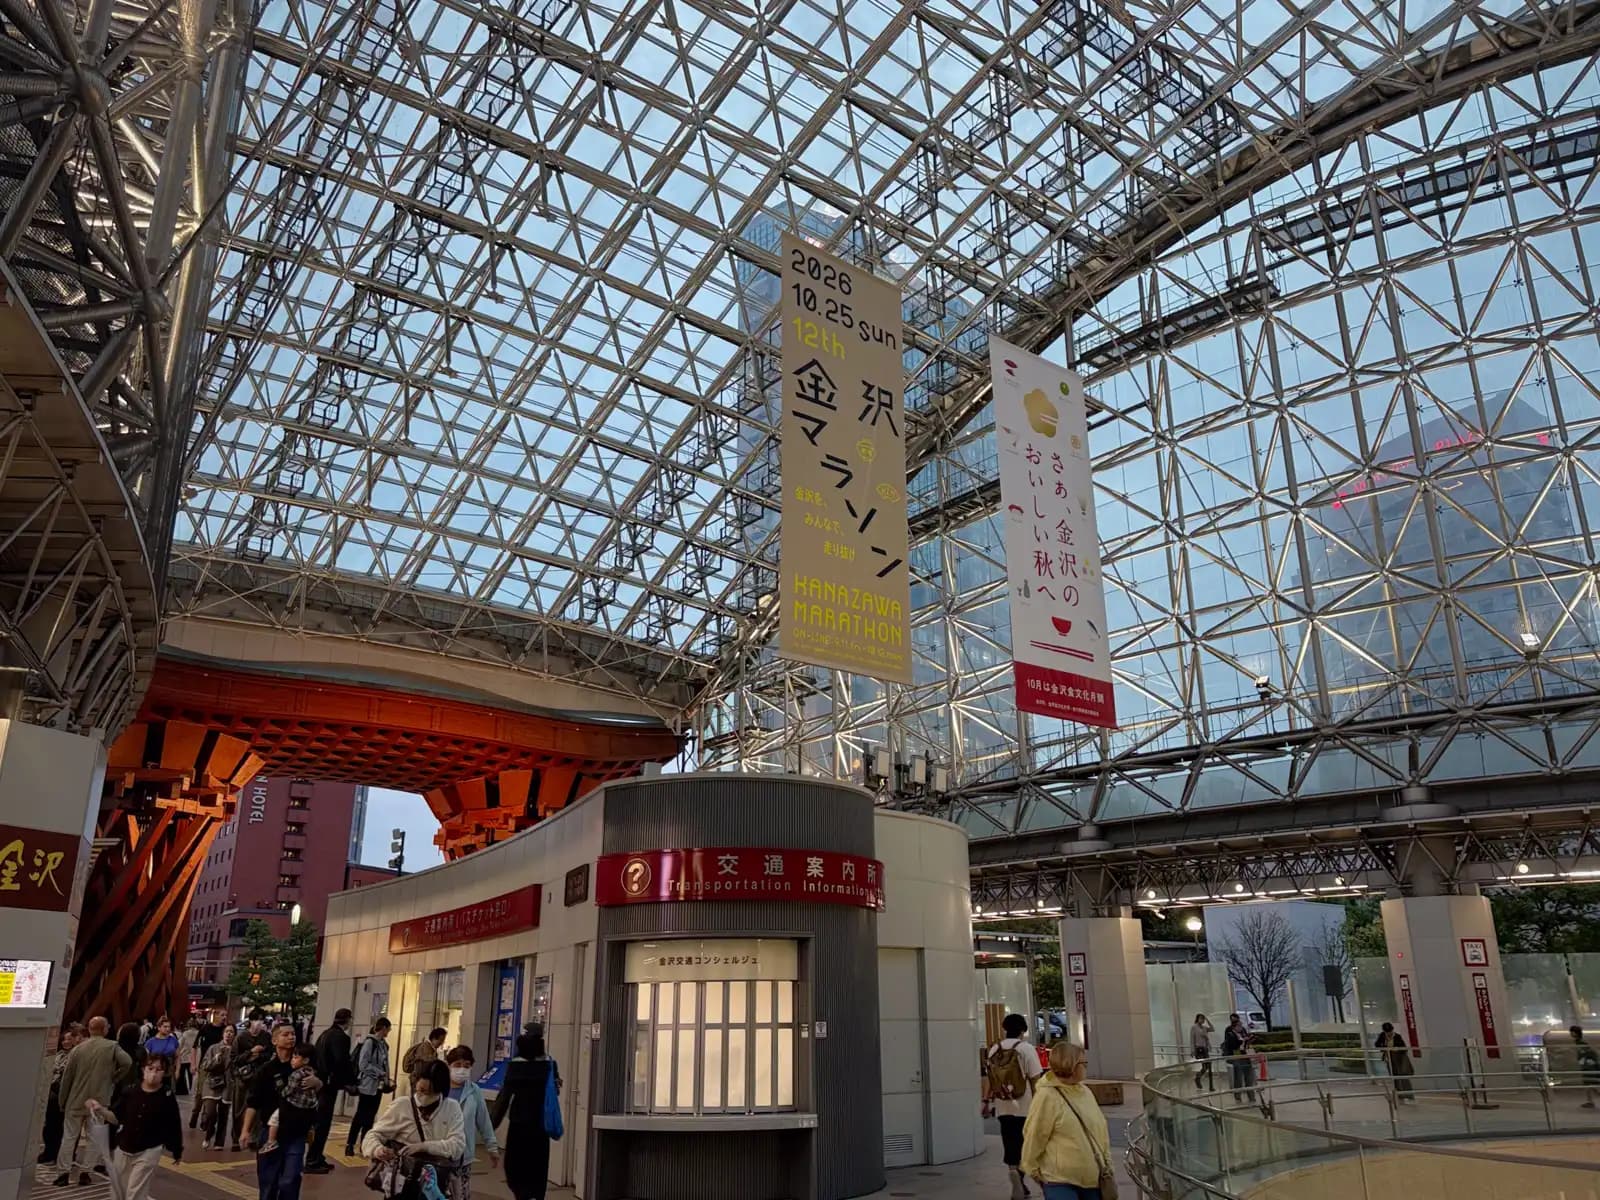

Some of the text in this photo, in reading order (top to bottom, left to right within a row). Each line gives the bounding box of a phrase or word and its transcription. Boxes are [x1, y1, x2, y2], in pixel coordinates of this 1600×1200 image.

[792, 249, 852, 295] 2026
[792, 283, 896, 350] 10.25 sun
[792, 316, 846, 360] 12th
[793, 358, 899, 437] 金沢
[792, 410, 903, 578] マラソン
[1026, 443, 1057, 601] おいしい秋へ
[793, 573, 902, 620] KANAZAWA
[793, 600, 902, 648] MARATHON
[249, 787, 267, 825] HOTEL
[0, 839, 65, 897] 金沢
[668, 879, 792, 893] Transportation
[803, 879, 869, 897] Information
[717, 854, 877, 885] 交通案内所
[659, 955, 758, 966] 金沢交通コンシェルジュ
